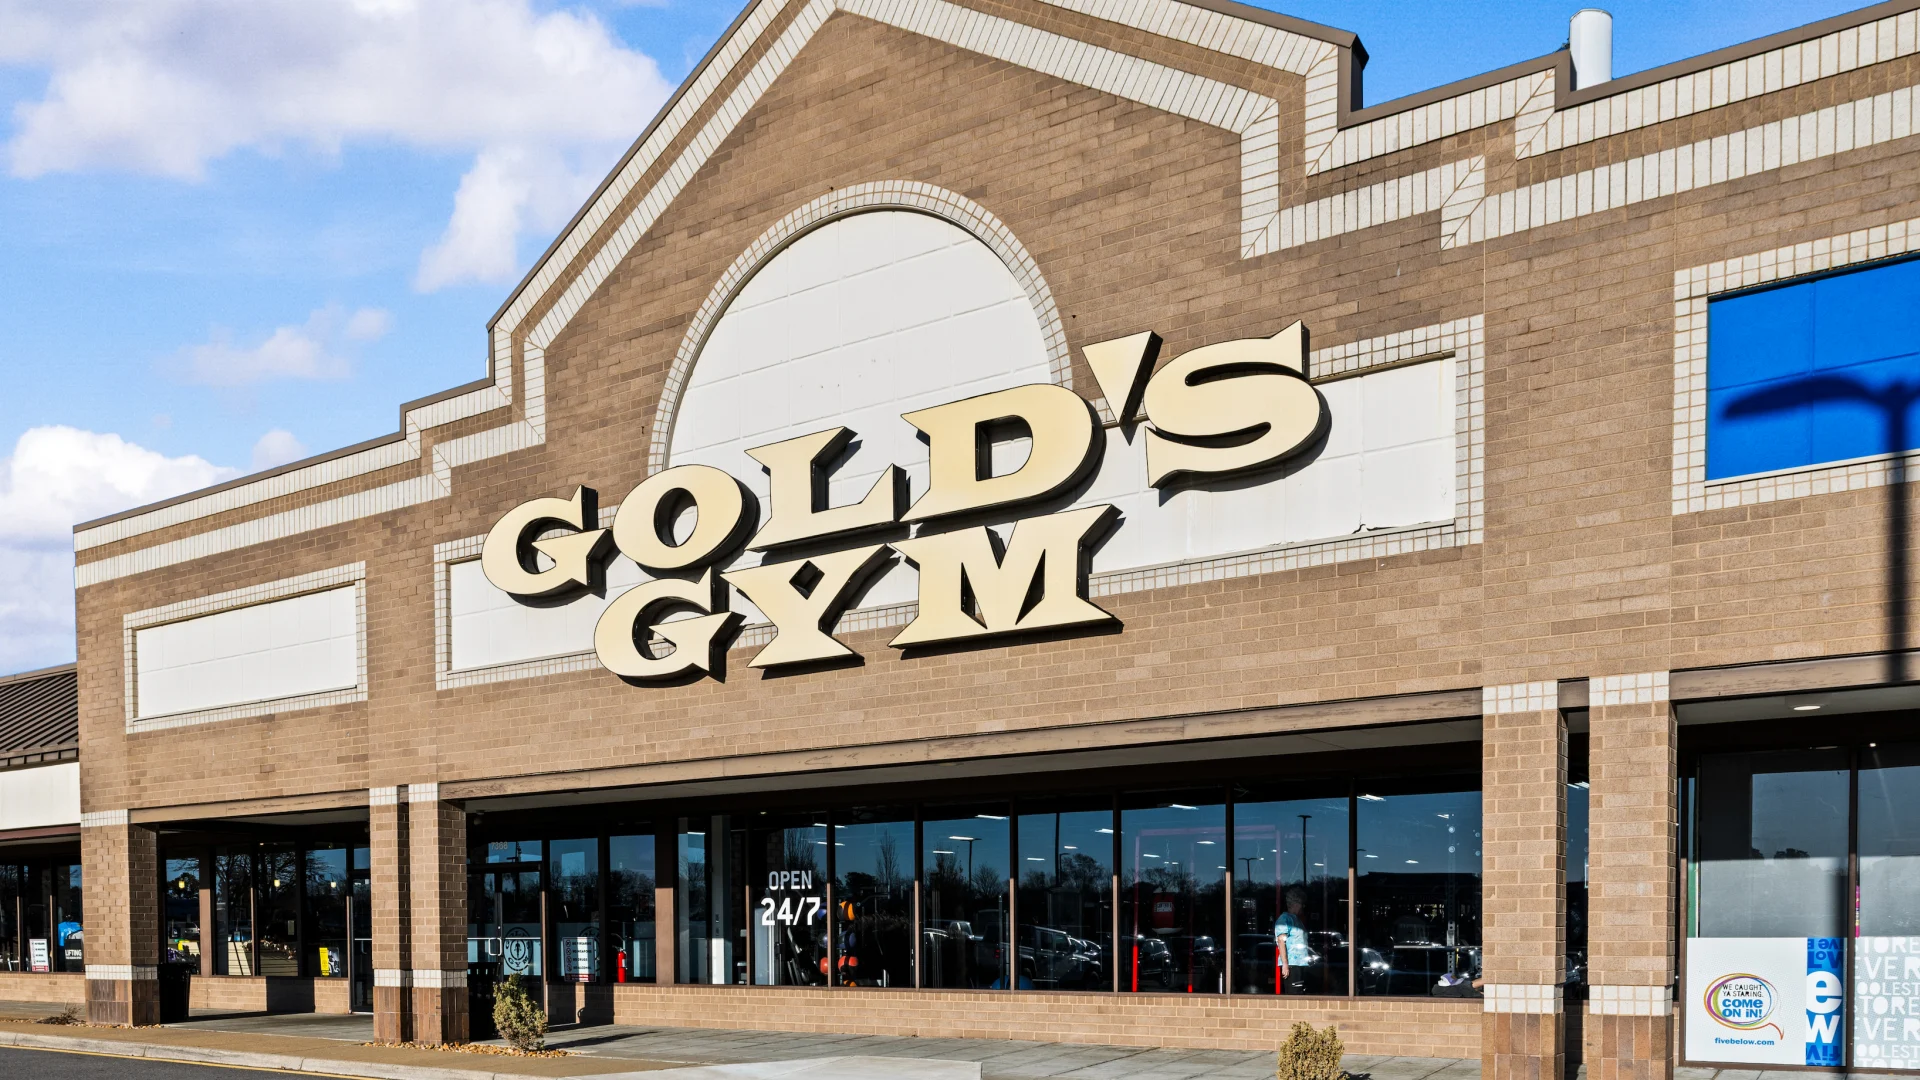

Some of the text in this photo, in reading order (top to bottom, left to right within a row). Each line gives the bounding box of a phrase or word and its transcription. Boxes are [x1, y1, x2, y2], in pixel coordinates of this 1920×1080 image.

[481, 320, 1322, 597] GOLD'S
[593, 504, 1120, 680] GYM
[768, 870, 812, 890] OPEN
[760, 896, 821, 926] 24/7
[1722, 1008, 1742, 1018] ON
[1714, 1037, 1775, 1046] fivebelow.com
